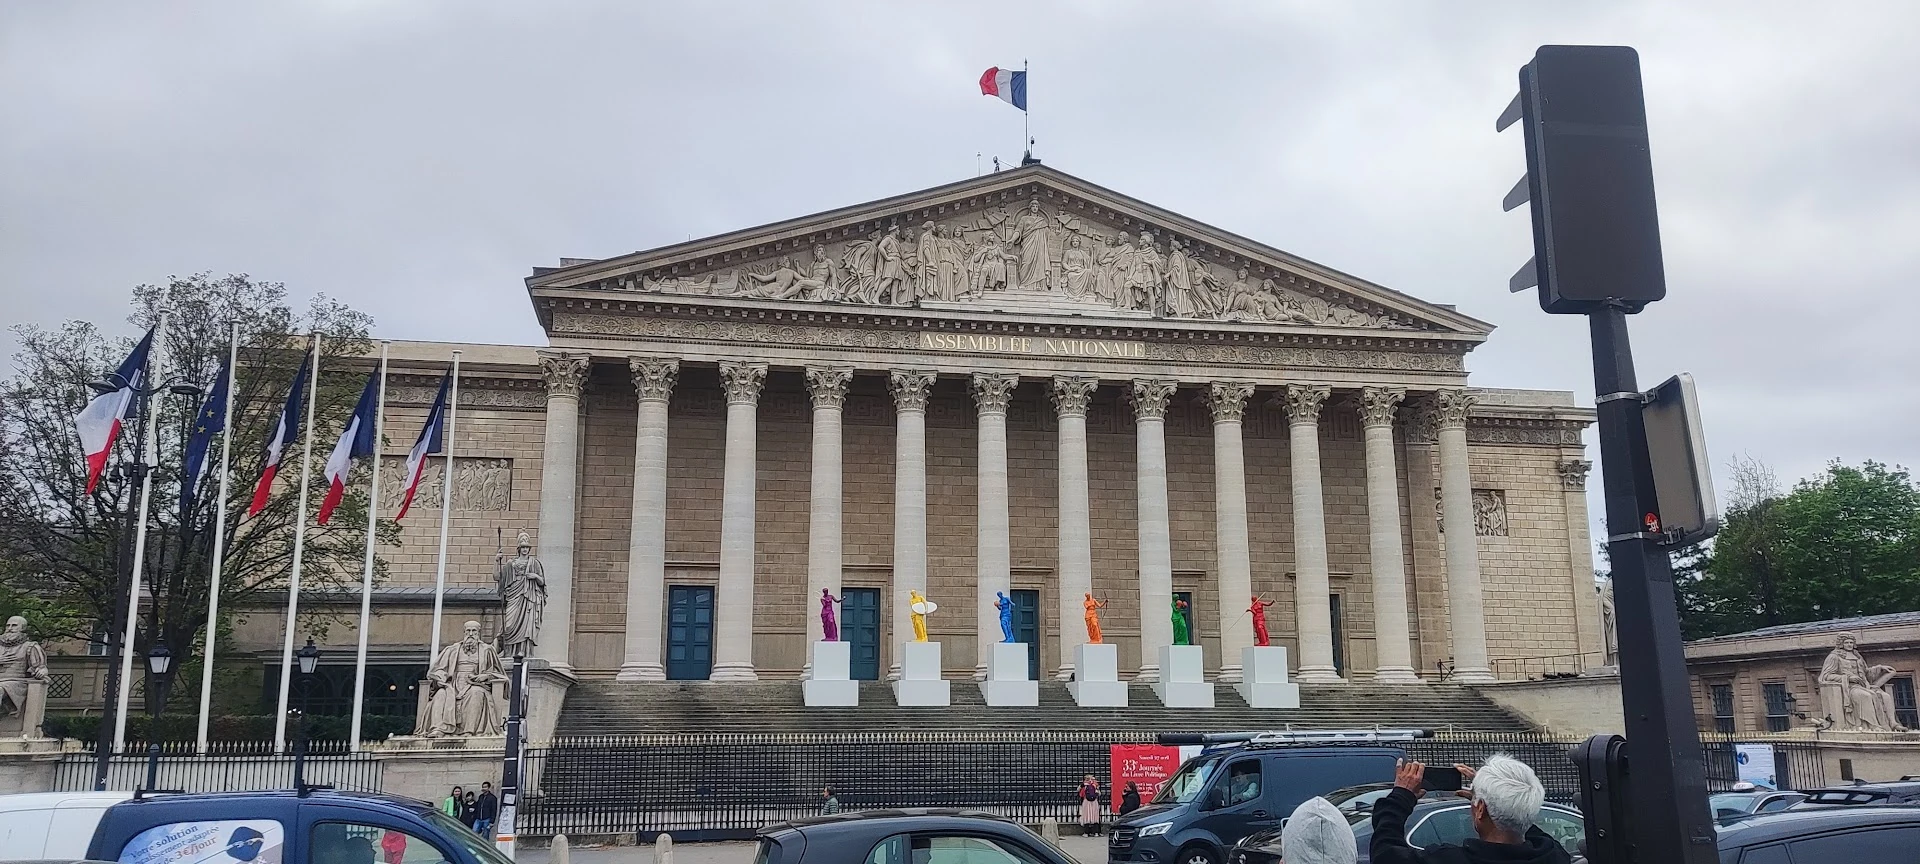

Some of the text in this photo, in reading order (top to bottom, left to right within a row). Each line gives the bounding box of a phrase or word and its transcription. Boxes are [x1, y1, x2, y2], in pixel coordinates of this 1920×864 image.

[921, 333, 1145, 358] ASSEMBLÉE NATIONALE
[1145, 771, 1167, 779] Politique
[130, 825, 199, 858] Votre solution
[187, 827, 220, 844] adaptée
[175, 836, 217, 860] 3€/jour
